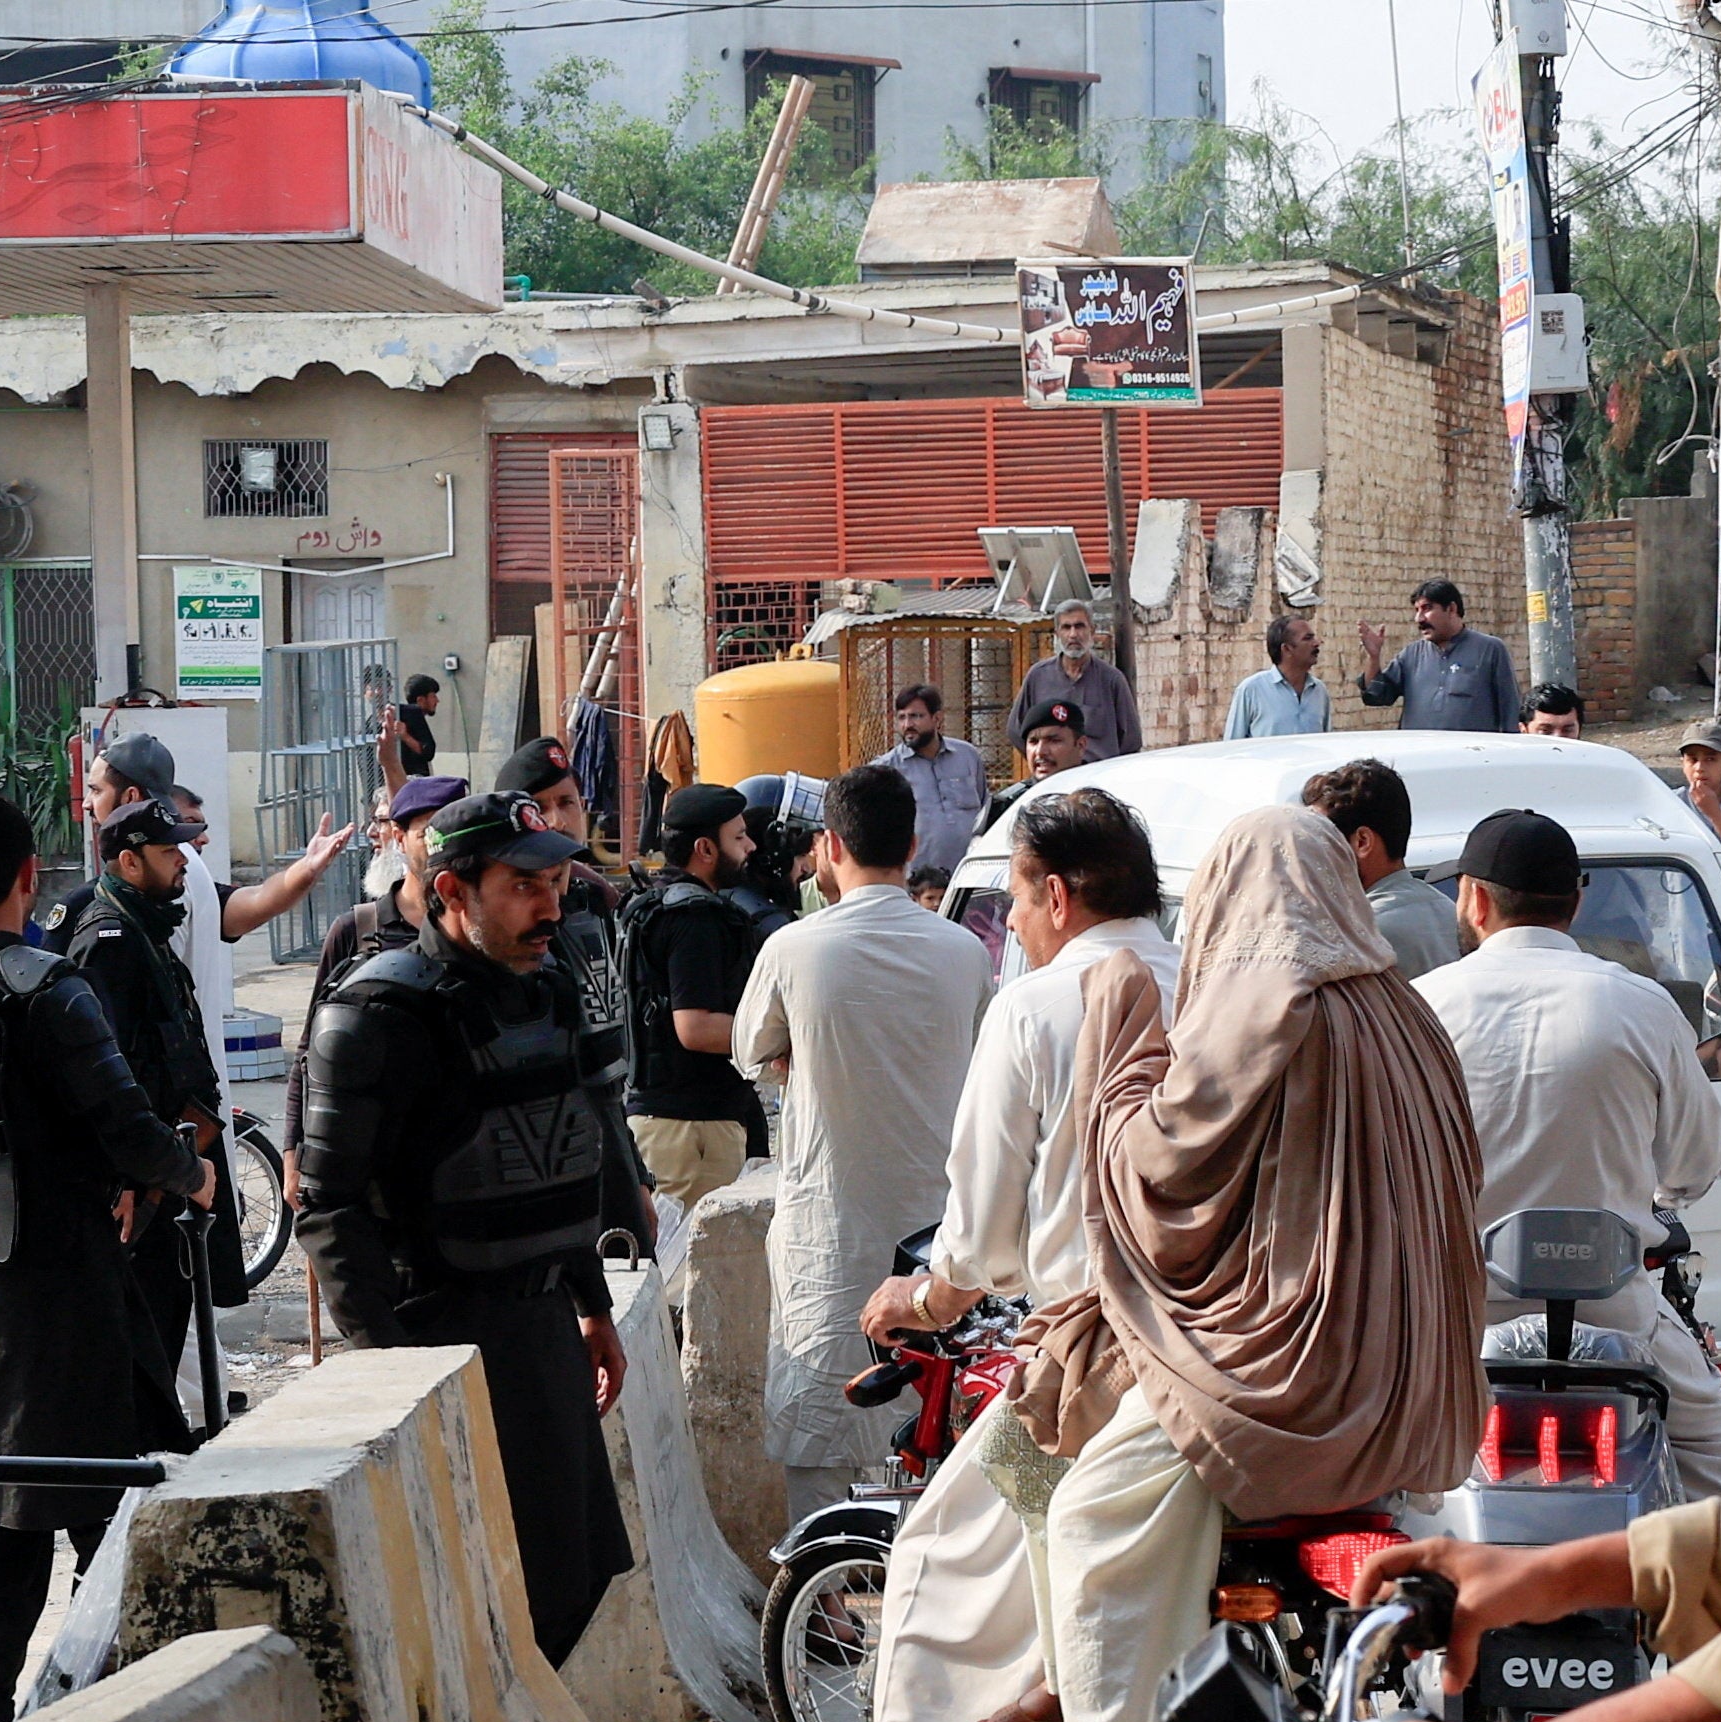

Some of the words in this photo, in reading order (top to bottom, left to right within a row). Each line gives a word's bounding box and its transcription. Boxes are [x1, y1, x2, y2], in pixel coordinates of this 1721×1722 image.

[365, 126, 409, 241] CNG
[296, 530, 330, 554] روم
[336, 516, 382, 553] واش
[1536, 1242, 1591, 1260] evee
[1502, 1656, 1614, 1690] evee
